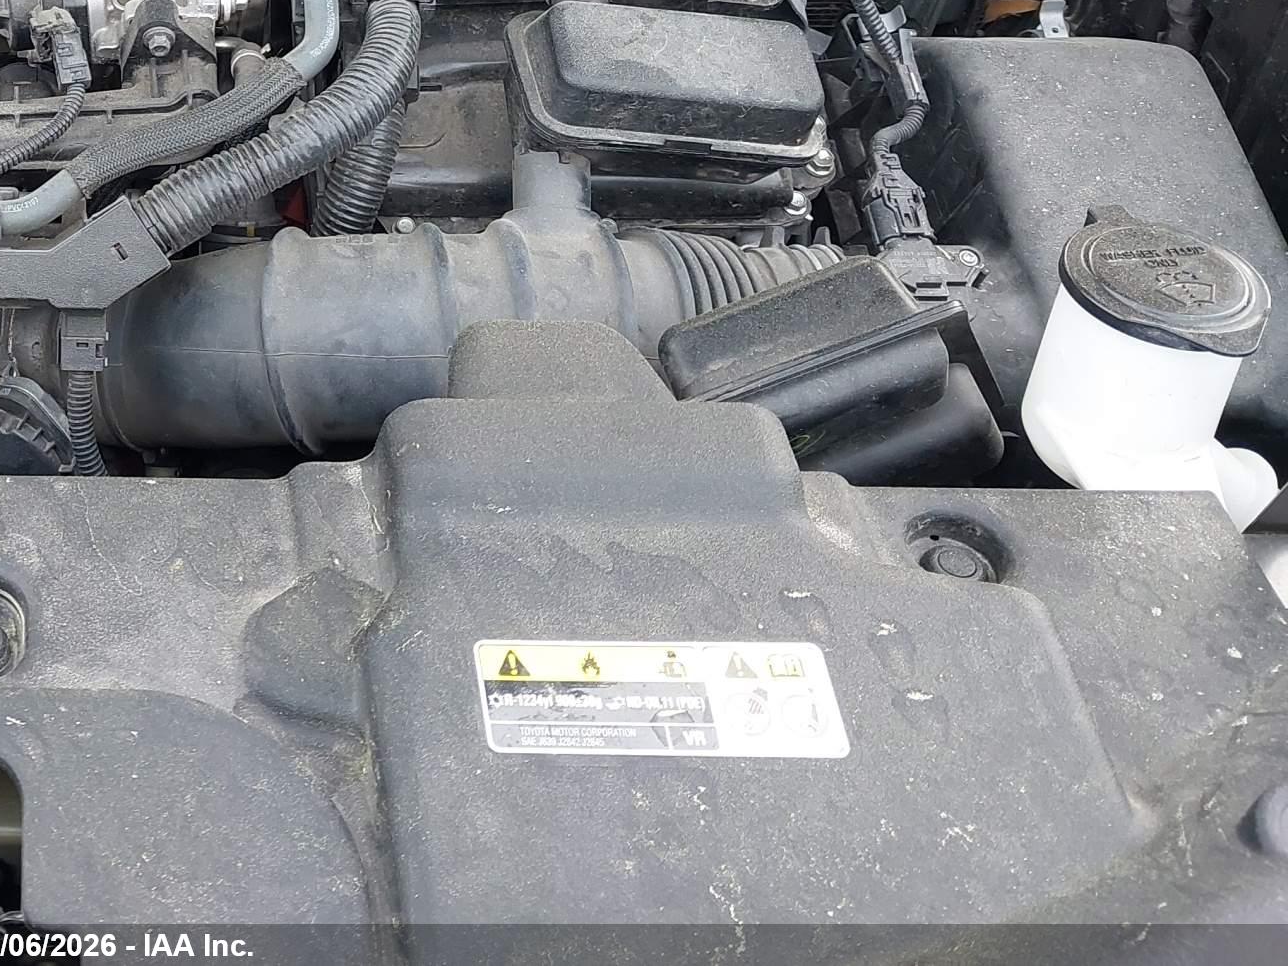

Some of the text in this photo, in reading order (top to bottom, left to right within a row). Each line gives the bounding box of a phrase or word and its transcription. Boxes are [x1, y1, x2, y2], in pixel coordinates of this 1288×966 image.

[1099, 245, 1207, 261] WASHER FLUID
[519, 726, 637, 738] TOYOTA MOTOR CORPORATION
[520, 736, 537, 747] SAE
